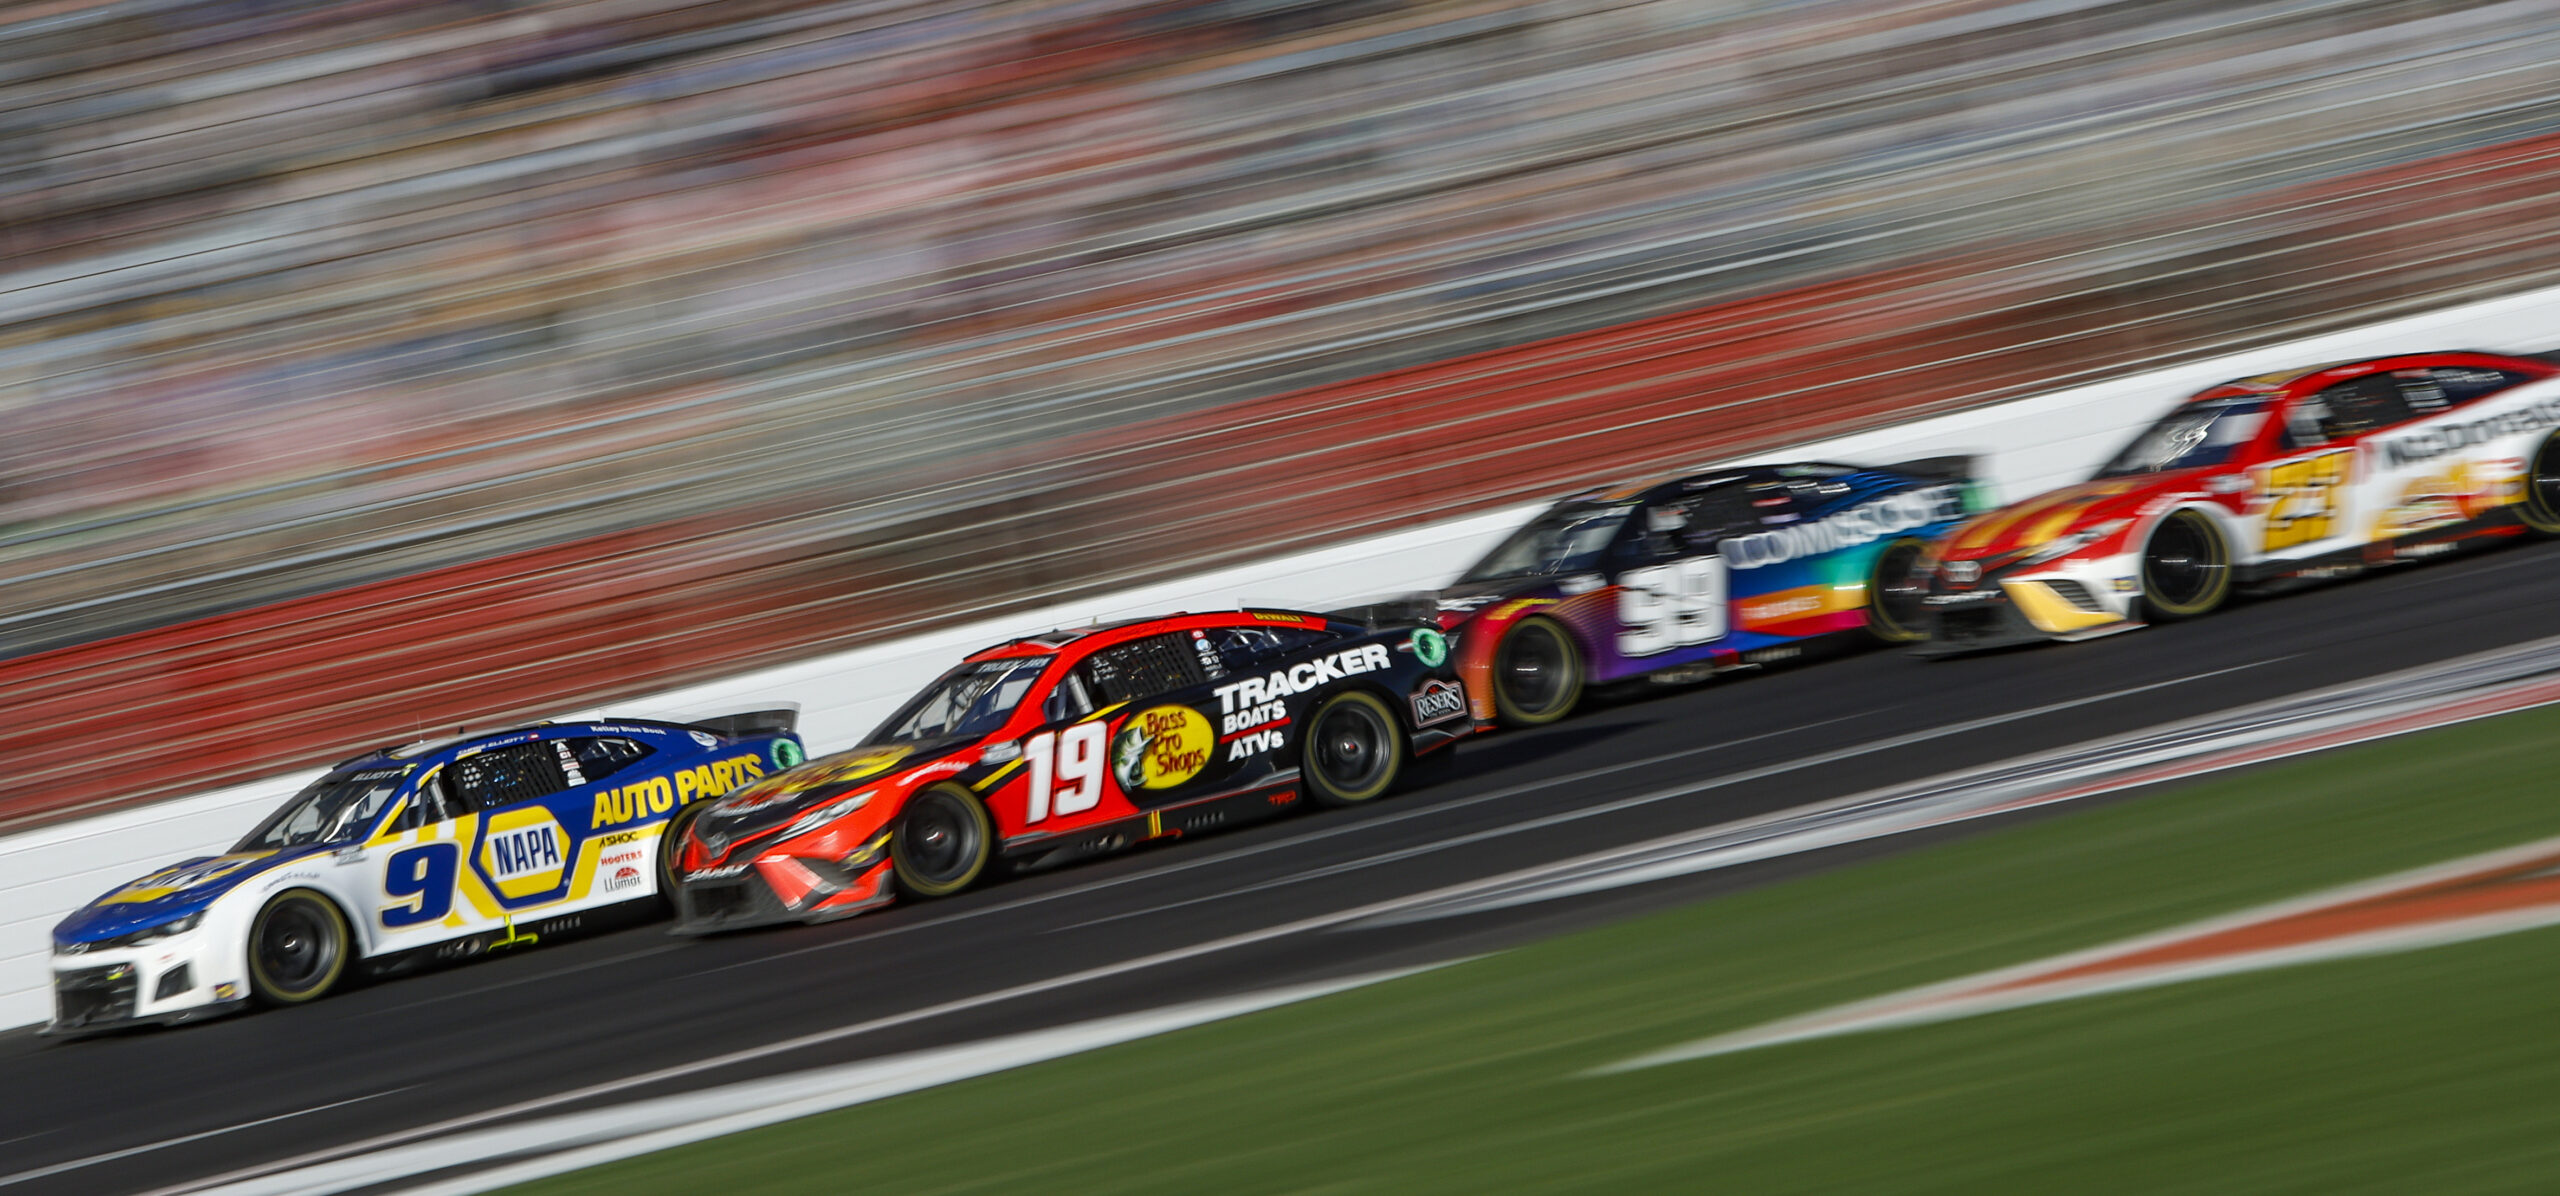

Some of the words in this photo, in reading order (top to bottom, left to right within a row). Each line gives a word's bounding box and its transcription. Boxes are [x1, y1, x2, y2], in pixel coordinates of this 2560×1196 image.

[1212, 643, 1391, 714] TRACKER
[589, 725, 620, 734] Kelley
[620, 725, 642, 734] Blue
[641, 727, 668, 736] Book
[1146, 711, 1187, 736] Bass
[1223, 700, 1286, 735] BOATS
[1151, 733, 1182, 757] Pro
[1227, 730, 1284, 762] ATVs
[1023, 720, 1107, 825] 19
[1156, 747, 1206, 777] Shops
[591, 776, 674, 830] AUTO
[674, 753, 765, 805] PARTS
[494, 827, 559, 876] NAPA
[600, 849, 643, 866] HOOTERS
[380, 841, 461, 930] 9
